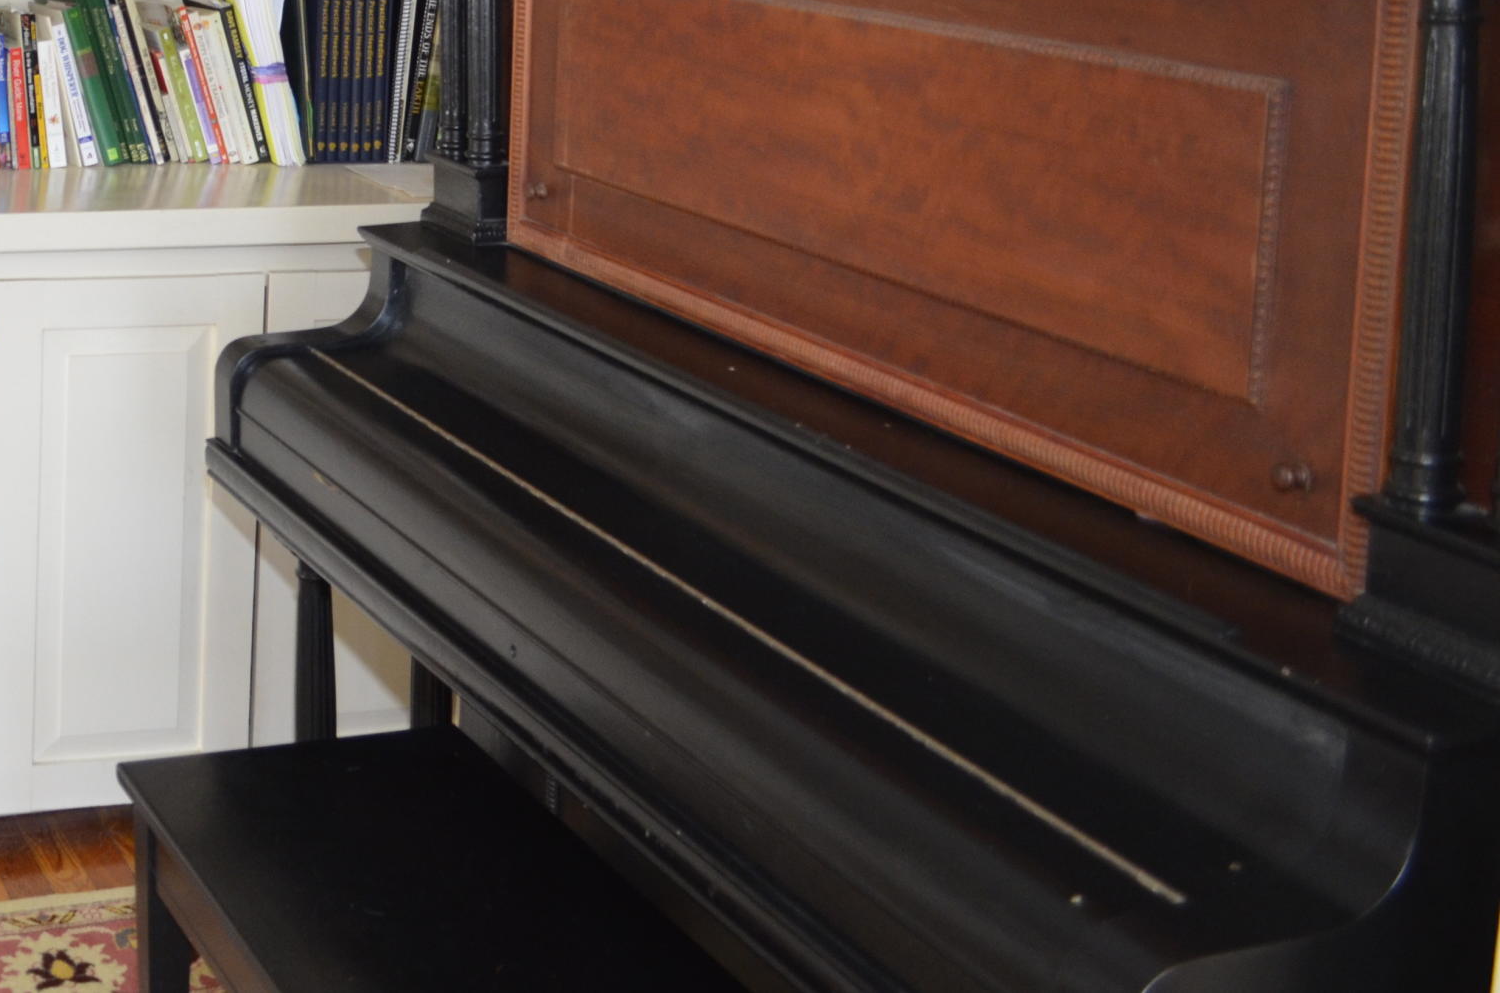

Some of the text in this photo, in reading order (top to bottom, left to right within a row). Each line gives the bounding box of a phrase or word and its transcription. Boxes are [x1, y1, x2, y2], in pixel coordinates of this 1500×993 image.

[321, 0, 329, 32] Practical
[332, 0, 340, 32] Practical
[343, 0, 351, 32] Practical
[356, 0, 364, 32] Practical
[367, 0, 375, 32] Practical
[423, 12, 435, 39] ENDS
[225, 10, 242, 58] DAVE RAMSEY
[422, 42, 431, 55] OF
[58, 37, 78, 97] DOG WHISPERER
[418, 59, 429, 78] THE
[244, 84, 256, 108] MONEY
[412, 80, 426, 114] EARTH
